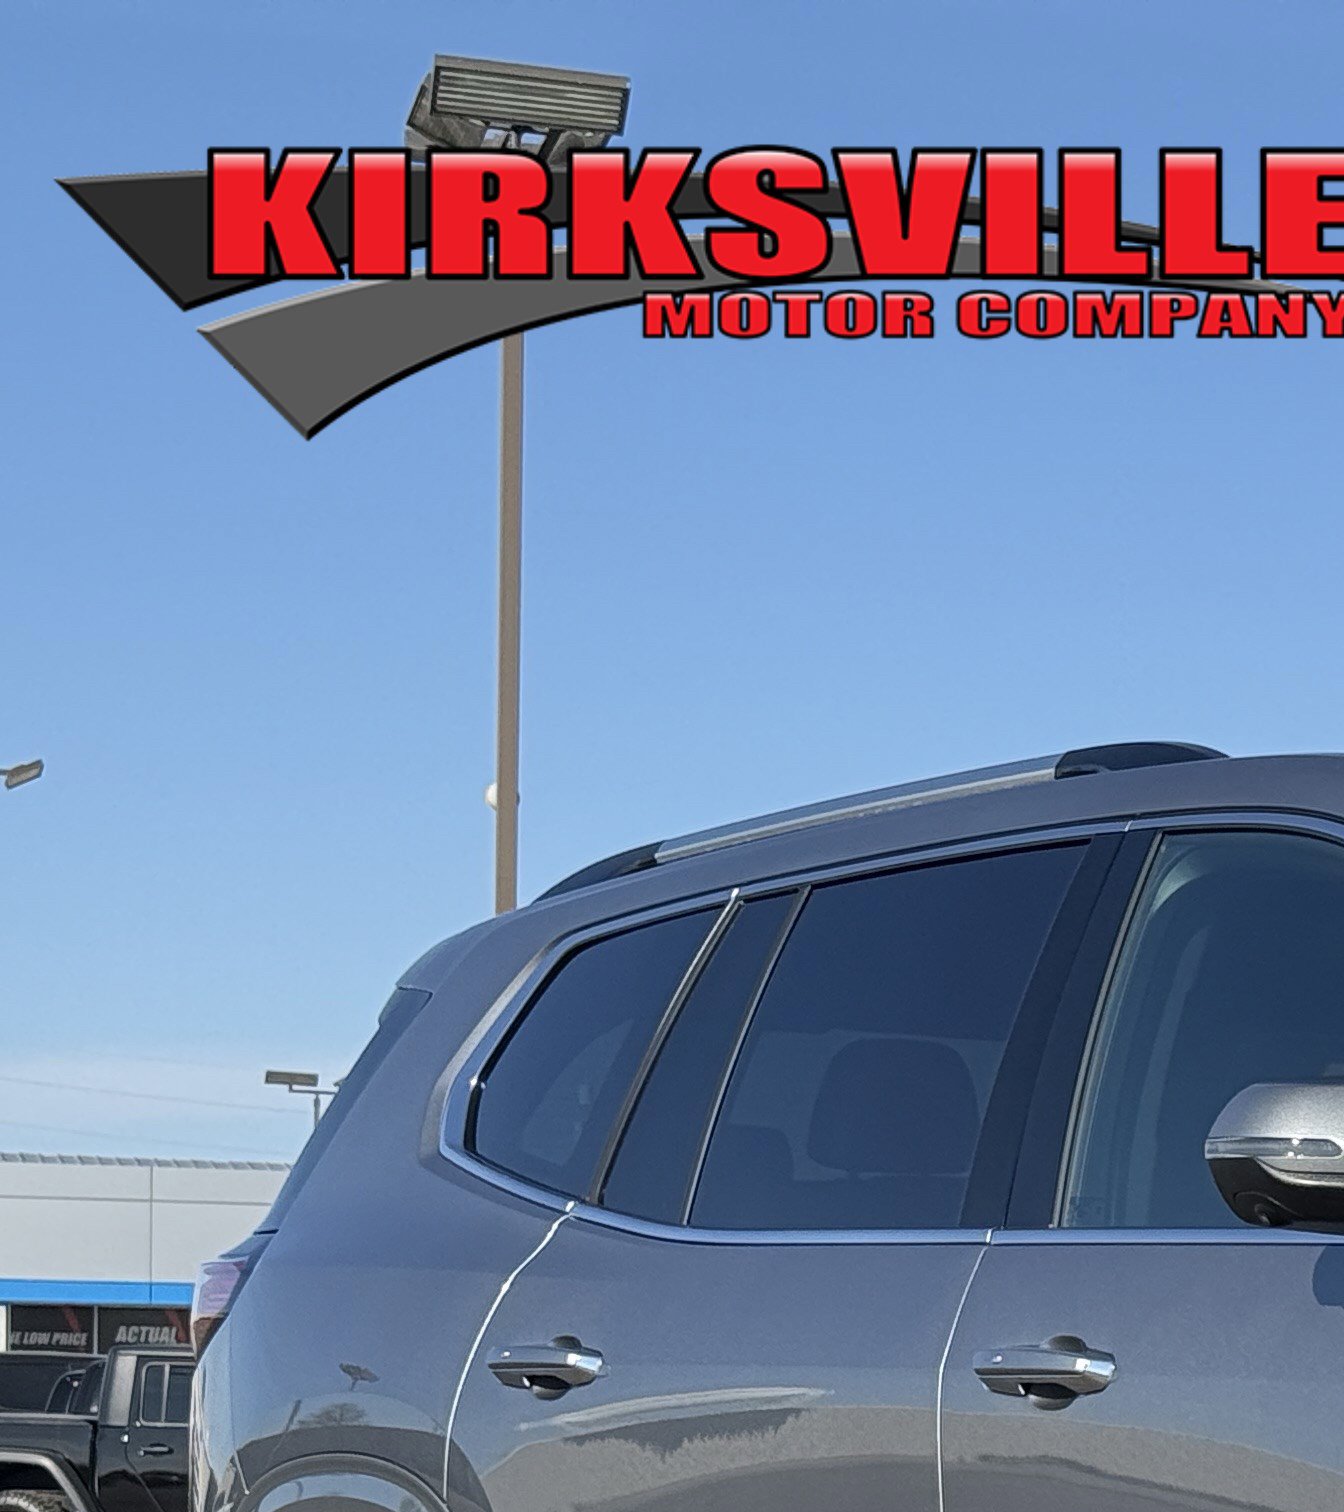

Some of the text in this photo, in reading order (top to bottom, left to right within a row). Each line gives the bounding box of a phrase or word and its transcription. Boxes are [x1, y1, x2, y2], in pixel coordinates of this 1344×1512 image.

[23, 1331, 50, 1346] LOW
[51, 1331, 90, 1347] PRICE
[115, 1325, 179, 1345] ACTUAL
